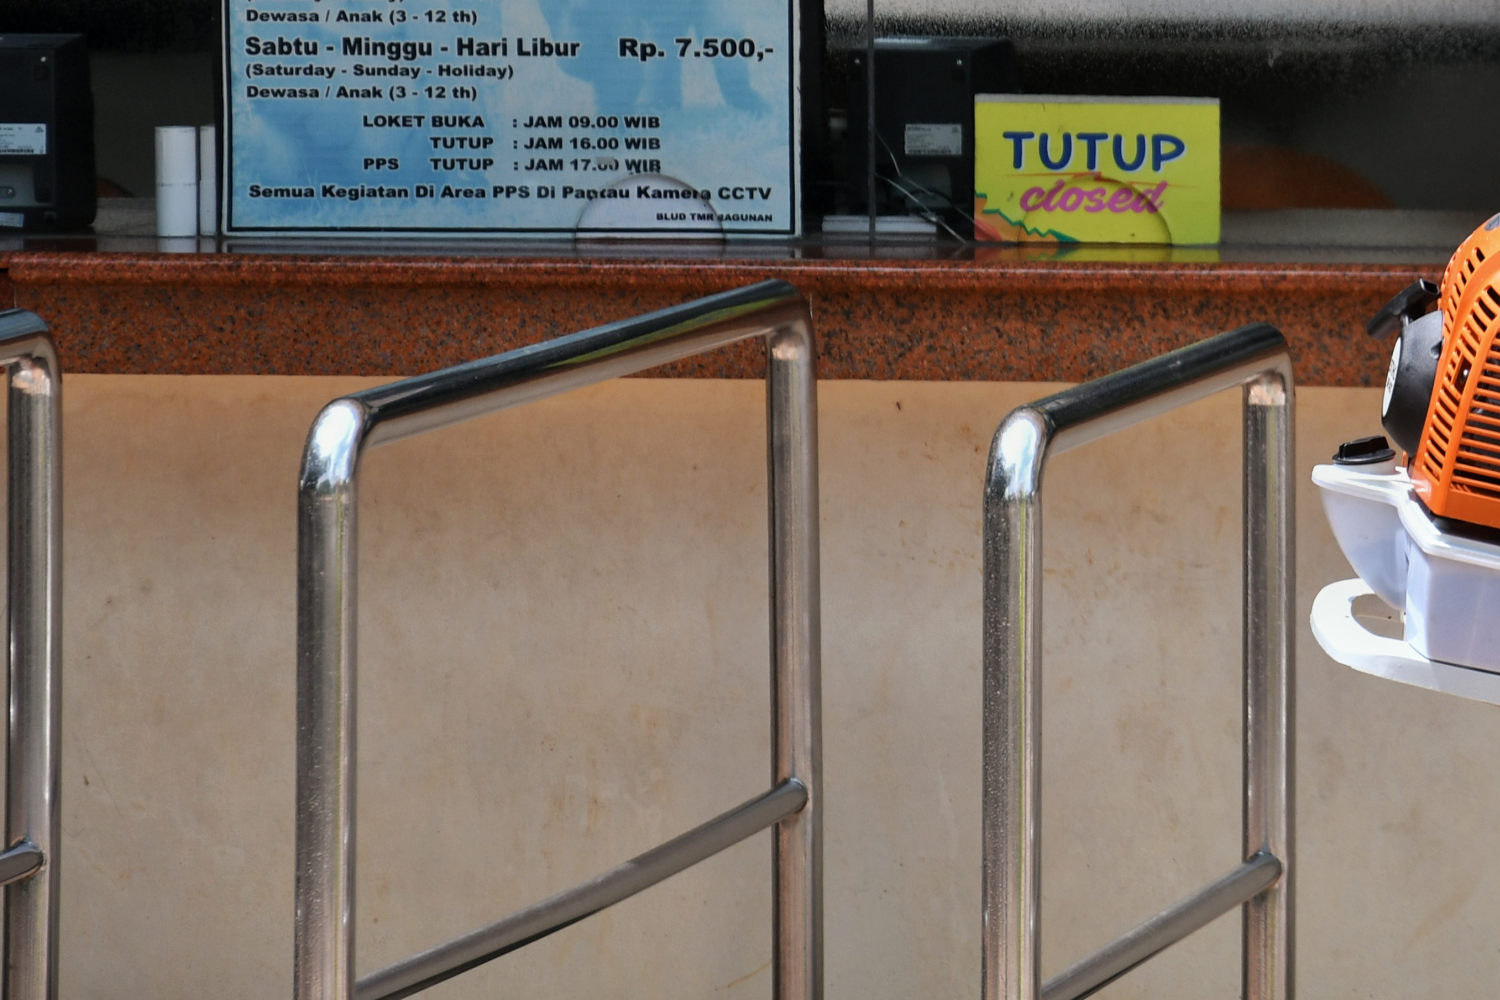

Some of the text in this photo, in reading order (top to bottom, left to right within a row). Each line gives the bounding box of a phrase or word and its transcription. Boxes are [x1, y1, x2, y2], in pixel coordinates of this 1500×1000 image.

[246, 9, 477, 25] Dewasa Anak (3 12 th)
[245, 37, 774, 61] Sabtu Minggu Hari Libur Rp. 7.500,-
[246, 63, 513, 79] (Saturday Sunday Holiday)
[246, 86, 477, 101] Dewasa Anak (3 12 th)
[362, 115, 660, 128] LOKET BUKA JAM 09.00 WIB
[430, 137, 660, 150] TUTUP JAM 16.00 WIB
[1002, 130, 1186, 172] TUTUP
[363, 158, 399, 170] PPS
[430, 158, 494, 170] TUTUP
[524, 159, 563, 171] JAM
[625, 159, 661, 173] WIB
[249, 185, 314, 198] Semua
[321, 185, 408, 200] Kegiatan
[415, 185, 434, 198] Di
[440, 186, 486, 198] Area
[492, 186, 530, 198] PPS
[537, 186, 556, 199] Di
[636, 187, 711, 200] Kamera
[717, 187, 772, 200] CCTV
[1018, 180, 1169, 214] closed
[656, 212, 686, 222] BLUD
[690, 212, 715, 222] TMR
